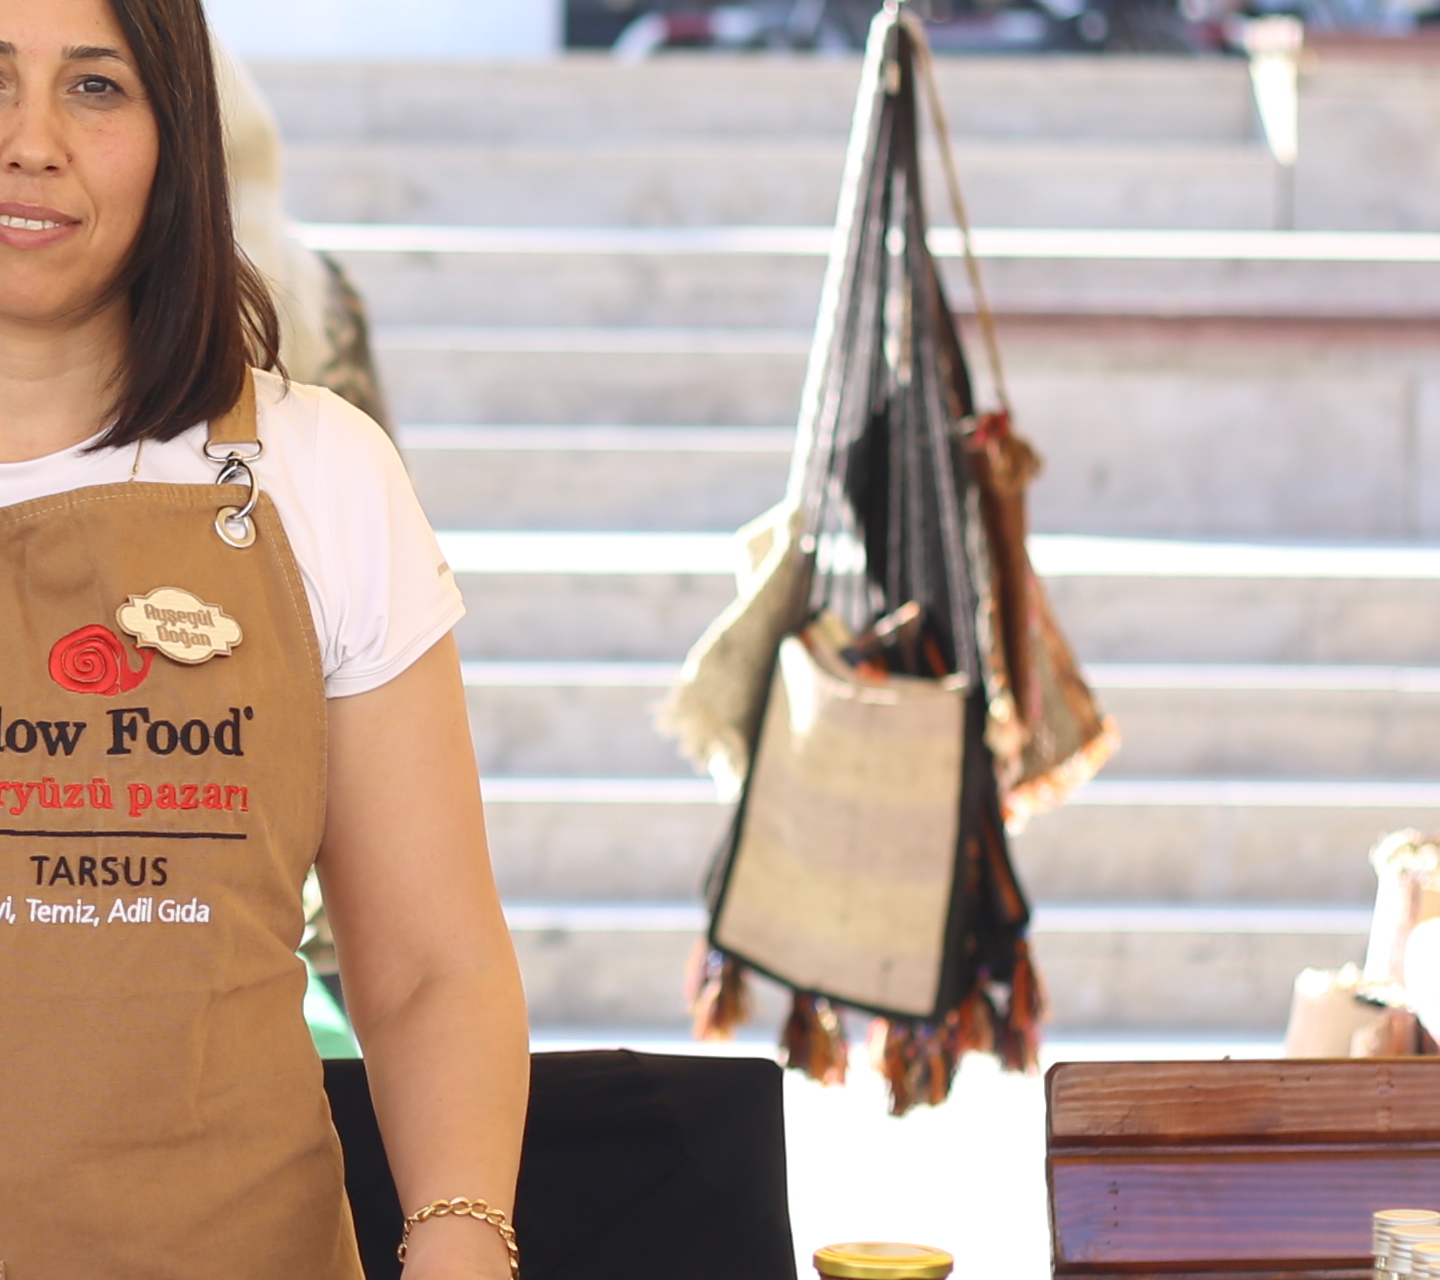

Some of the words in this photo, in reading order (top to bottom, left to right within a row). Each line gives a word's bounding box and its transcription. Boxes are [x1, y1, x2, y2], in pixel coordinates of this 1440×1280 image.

[143, 603, 215, 628] Ayşegül
[156, 625, 212, 648] Doğan
[106, 706, 244, 757] Food
[127, 781, 250, 818] pazarı
[30, 855, 168, 887] TARSUS
[26, 897, 100, 927] Temiz,
[107, 897, 152, 924] Adil
[157, 897, 210, 924] Gıda
